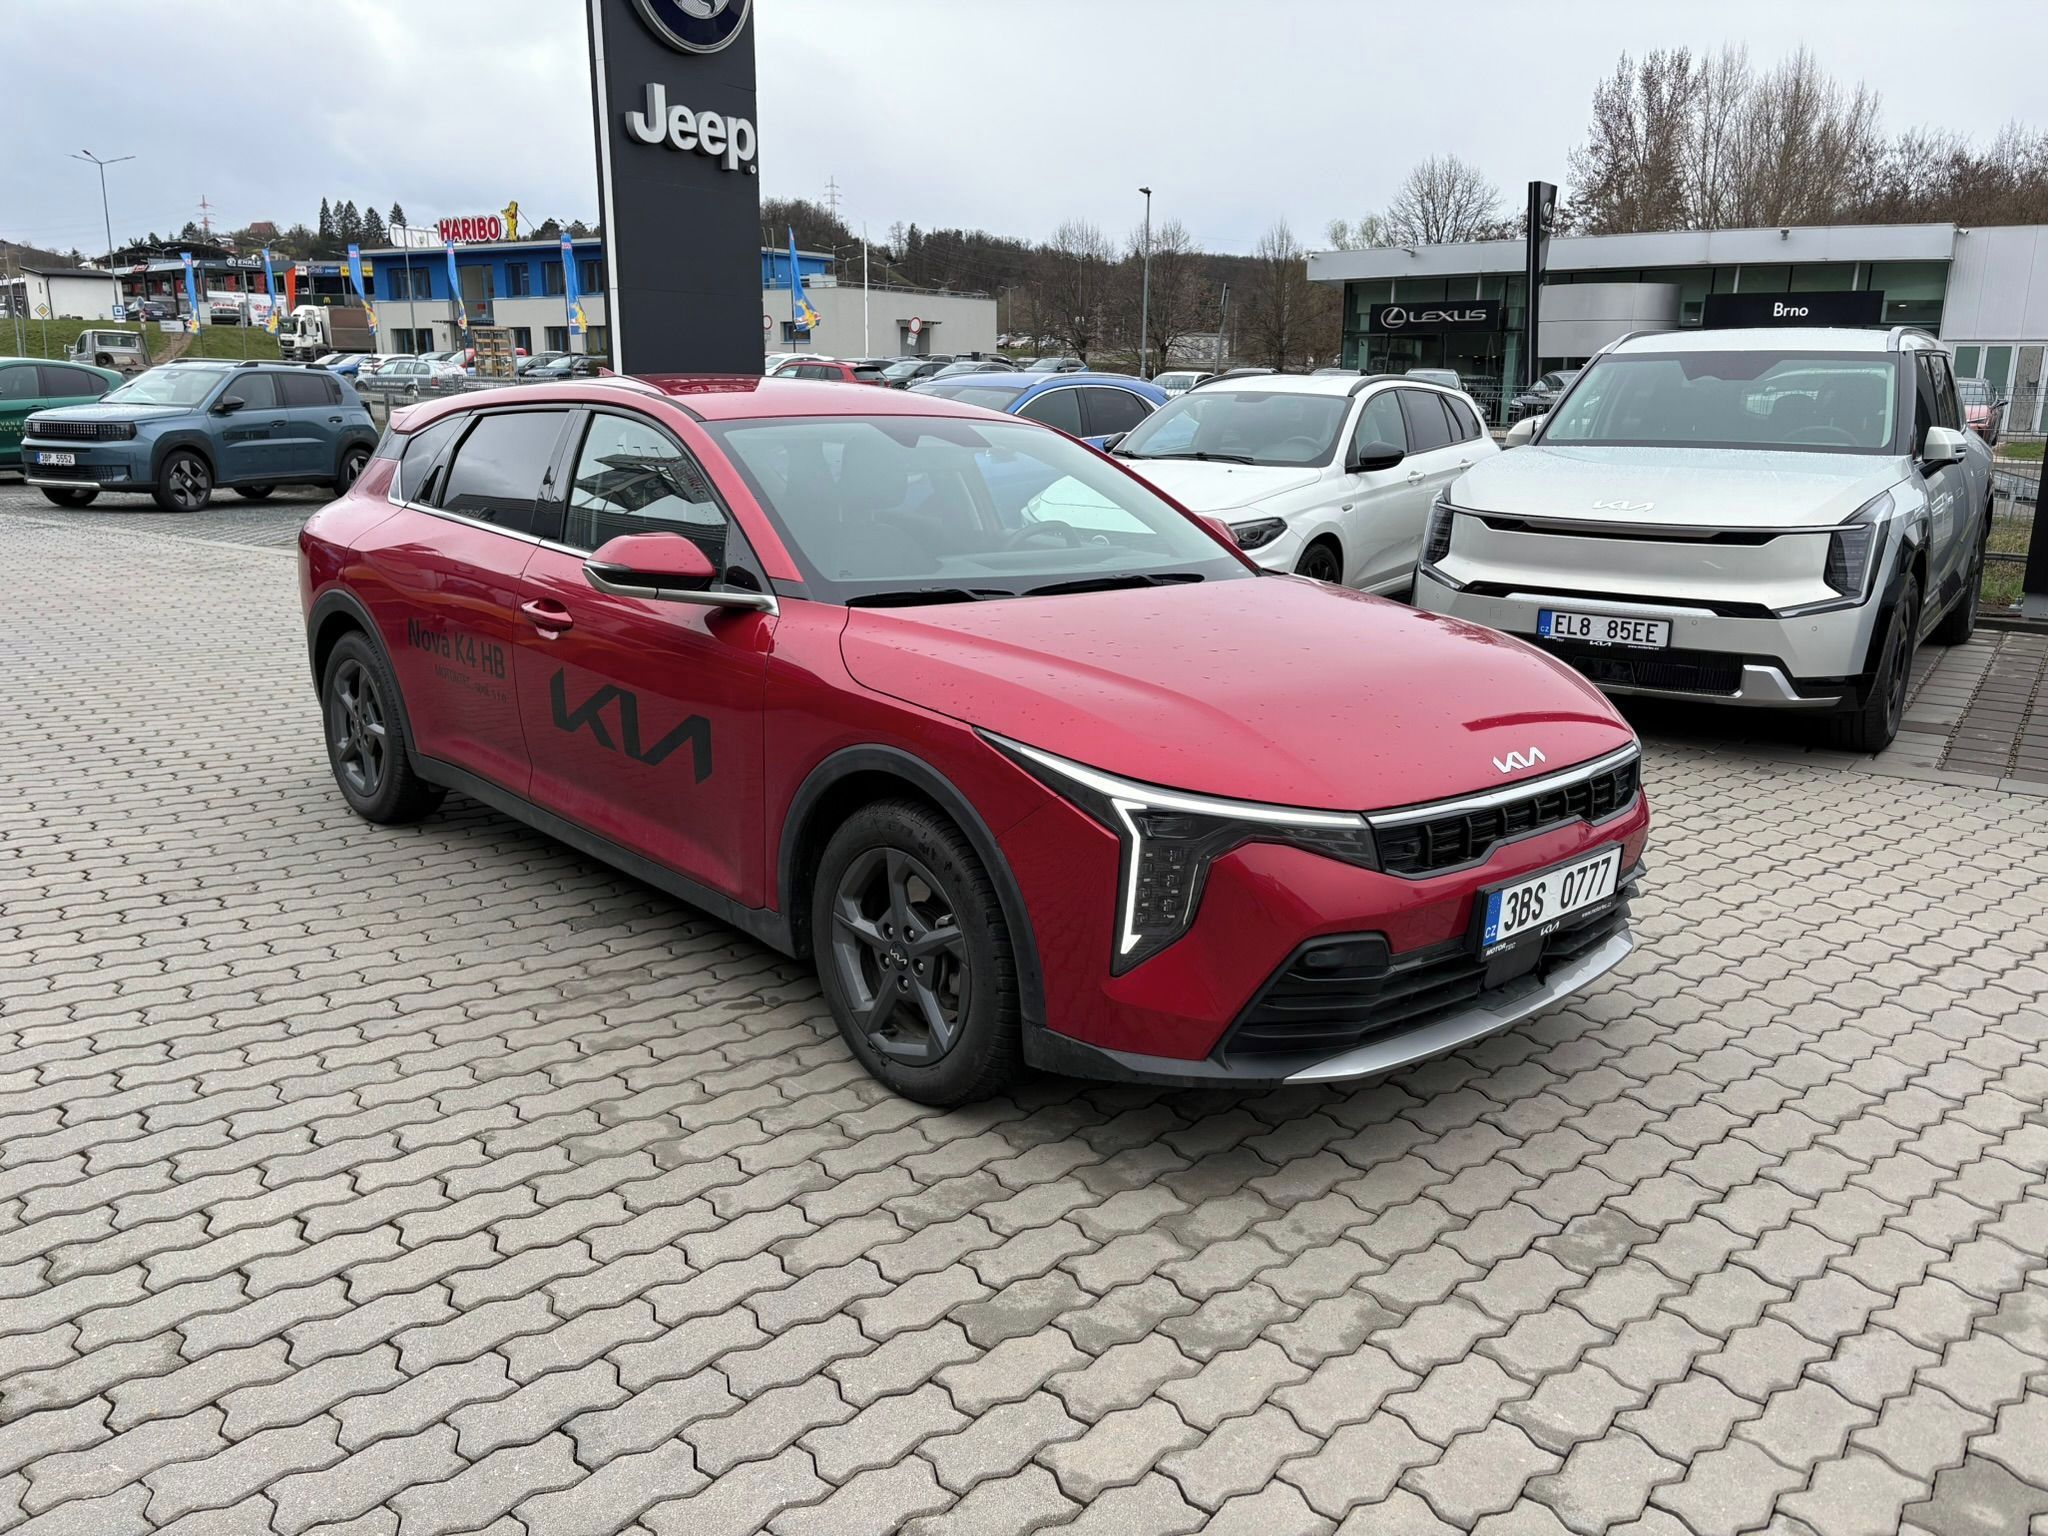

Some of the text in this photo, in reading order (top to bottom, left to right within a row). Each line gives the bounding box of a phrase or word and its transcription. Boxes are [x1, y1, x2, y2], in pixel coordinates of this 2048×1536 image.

[625, 83, 757, 172] Jeep
[438, 215, 502, 243] HARIBO
[1409, 309, 1487, 323] LEXUS
[1773, 302, 1809, 317] Brno
[56, 454, 72, 463] 5552
[1540, 625, 1550, 633] CZ
[1554, 614, 1659, 643] EL8 85EE
[408, 618, 505, 679] Nová K4 HB
[1503, 856, 1612, 932] 3BS 0777
[1485, 924, 1497, 939] CZ
